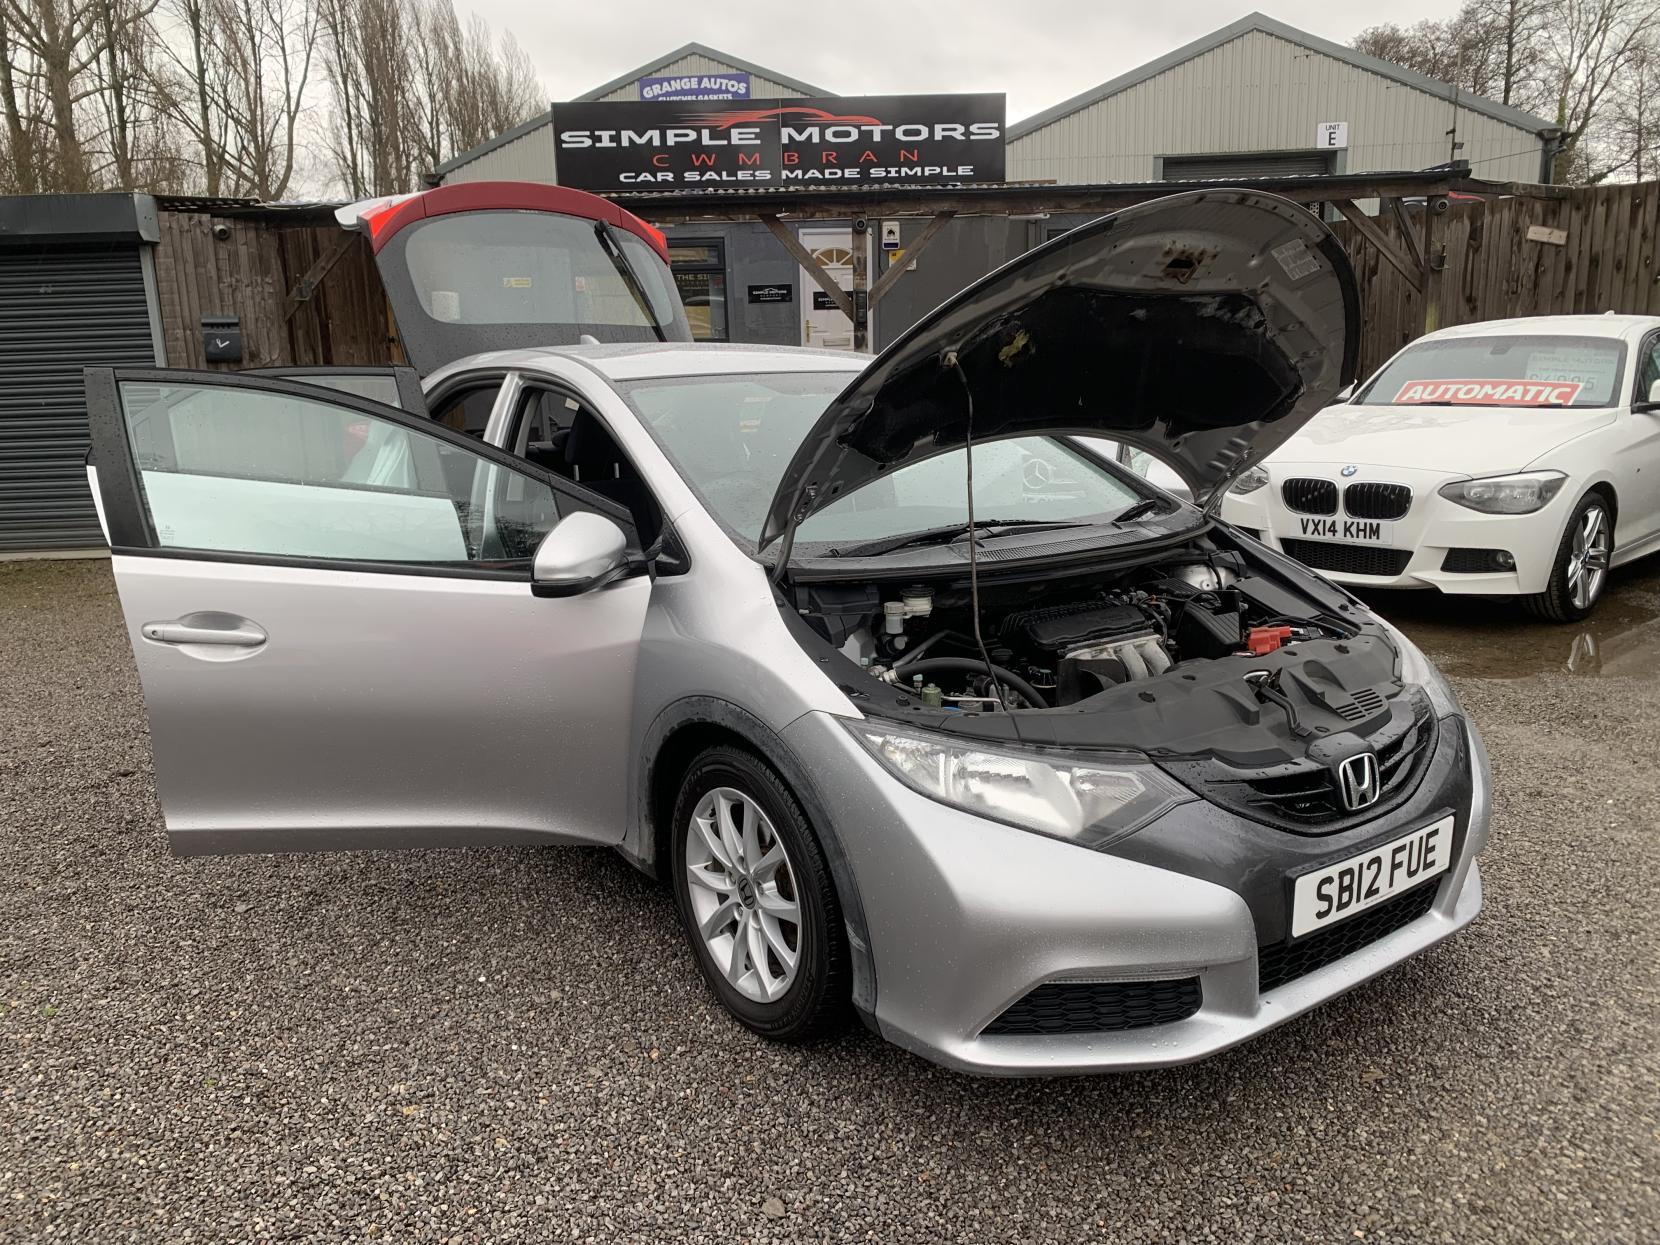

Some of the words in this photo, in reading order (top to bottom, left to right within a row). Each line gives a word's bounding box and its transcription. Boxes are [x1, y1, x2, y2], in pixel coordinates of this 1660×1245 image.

[643, 78, 698, 98] GRANGE
[700, 78, 747, 94] AUTOS
[560, 128, 761, 148] SIMPLE
[781, 123, 1000, 144] MOTORS
[1328, 131, 1337, 146] E
[653, 150, 918, 167] CWMBRAN
[619, 172, 674, 183] CAR
[683, 170, 772, 181] SALES
[782, 168, 861, 180] MADE
[869, 166, 974, 178] SIMPLE
[1404, 384, 1571, 404] AUTOMATIC
[1301, 518, 1338, 537] VX14
[1344, 521, 1380, 540] KHM
[1315, 855, 1381, 920] SB12
[1389, 828, 1439, 888] FUE
